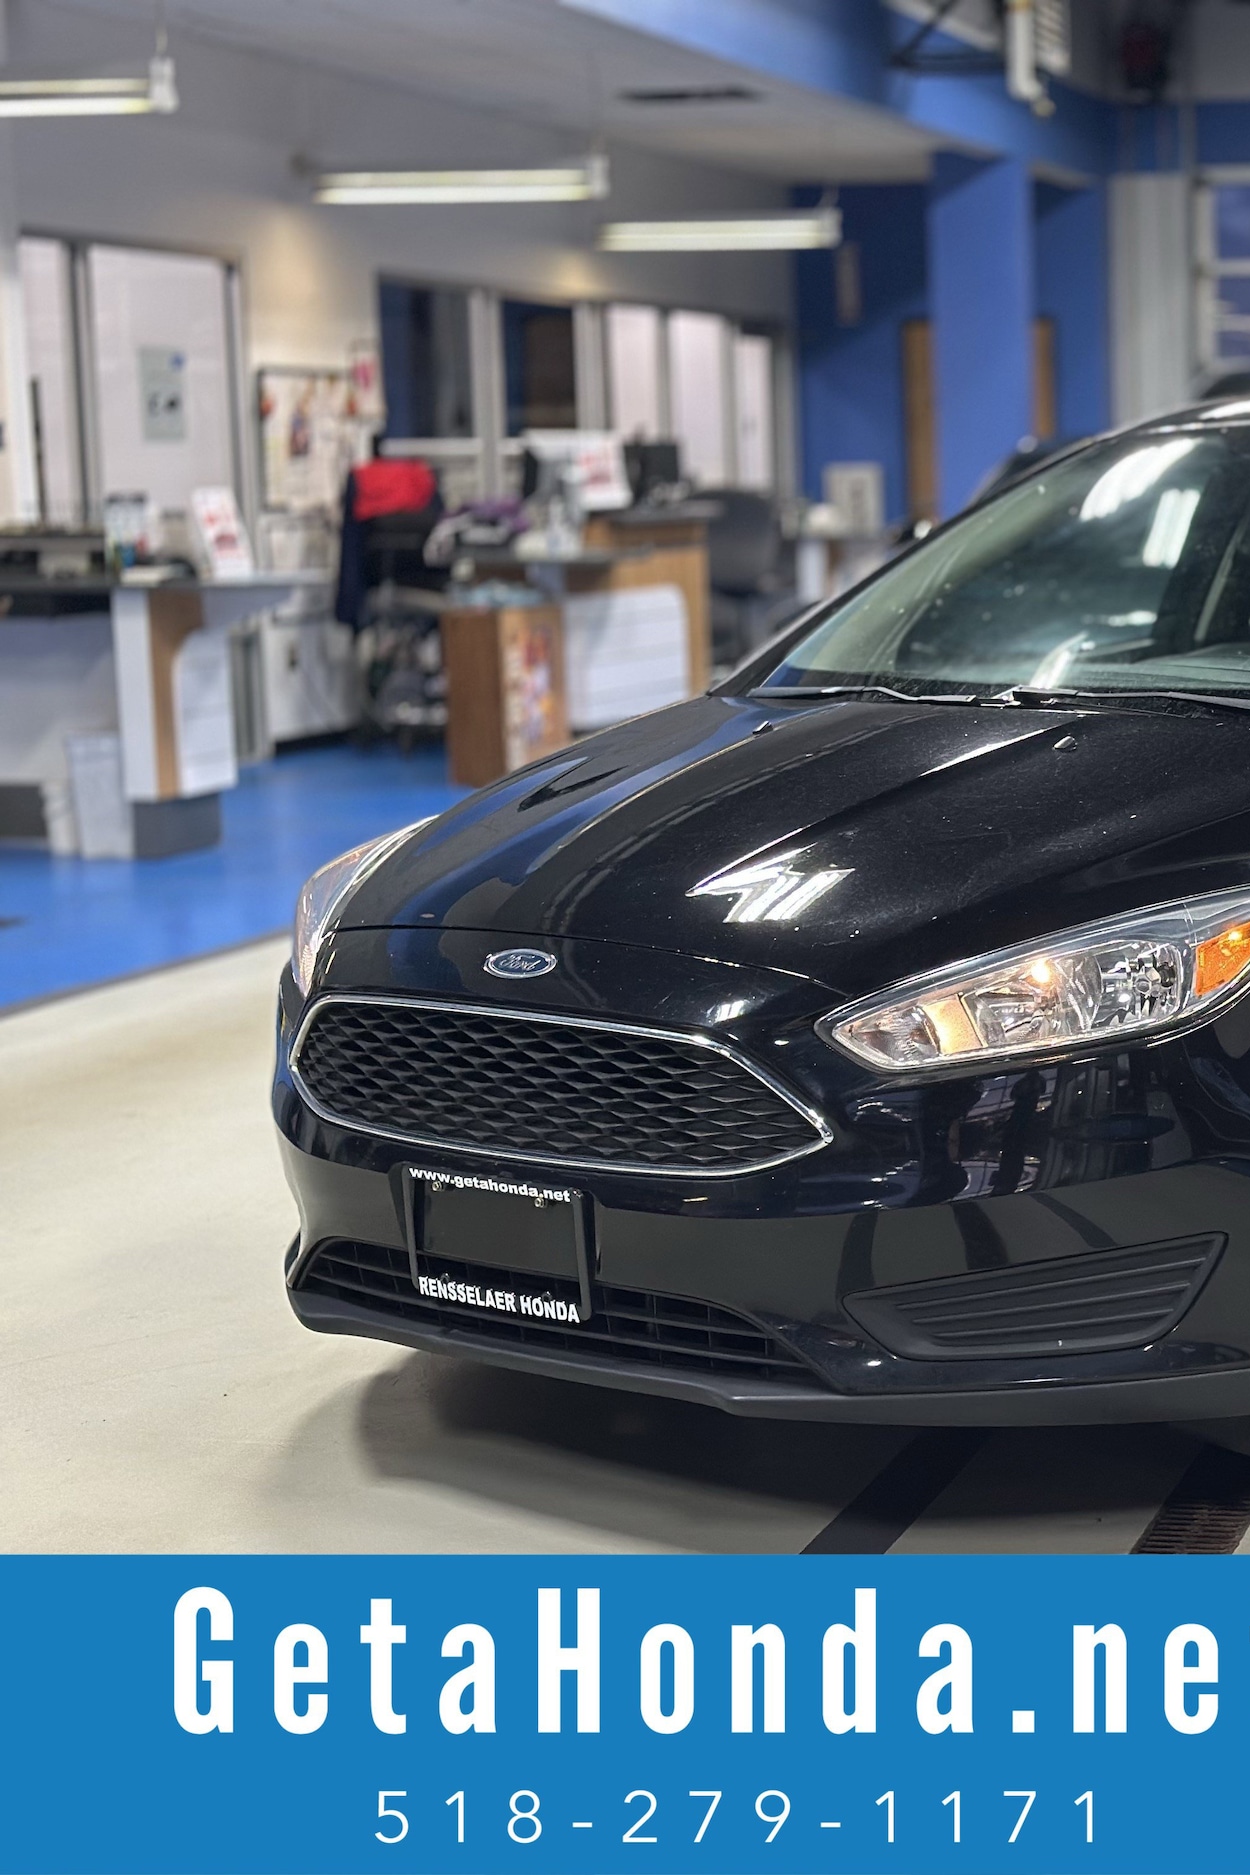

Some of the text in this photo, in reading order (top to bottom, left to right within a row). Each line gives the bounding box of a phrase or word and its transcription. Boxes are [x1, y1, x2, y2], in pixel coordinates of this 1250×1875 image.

[499, 954, 541, 971] Ford
[408, 1166, 571, 1202] www.getahonda.net
[418, 1276, 580, 1323] RENSSELAER HONDA
